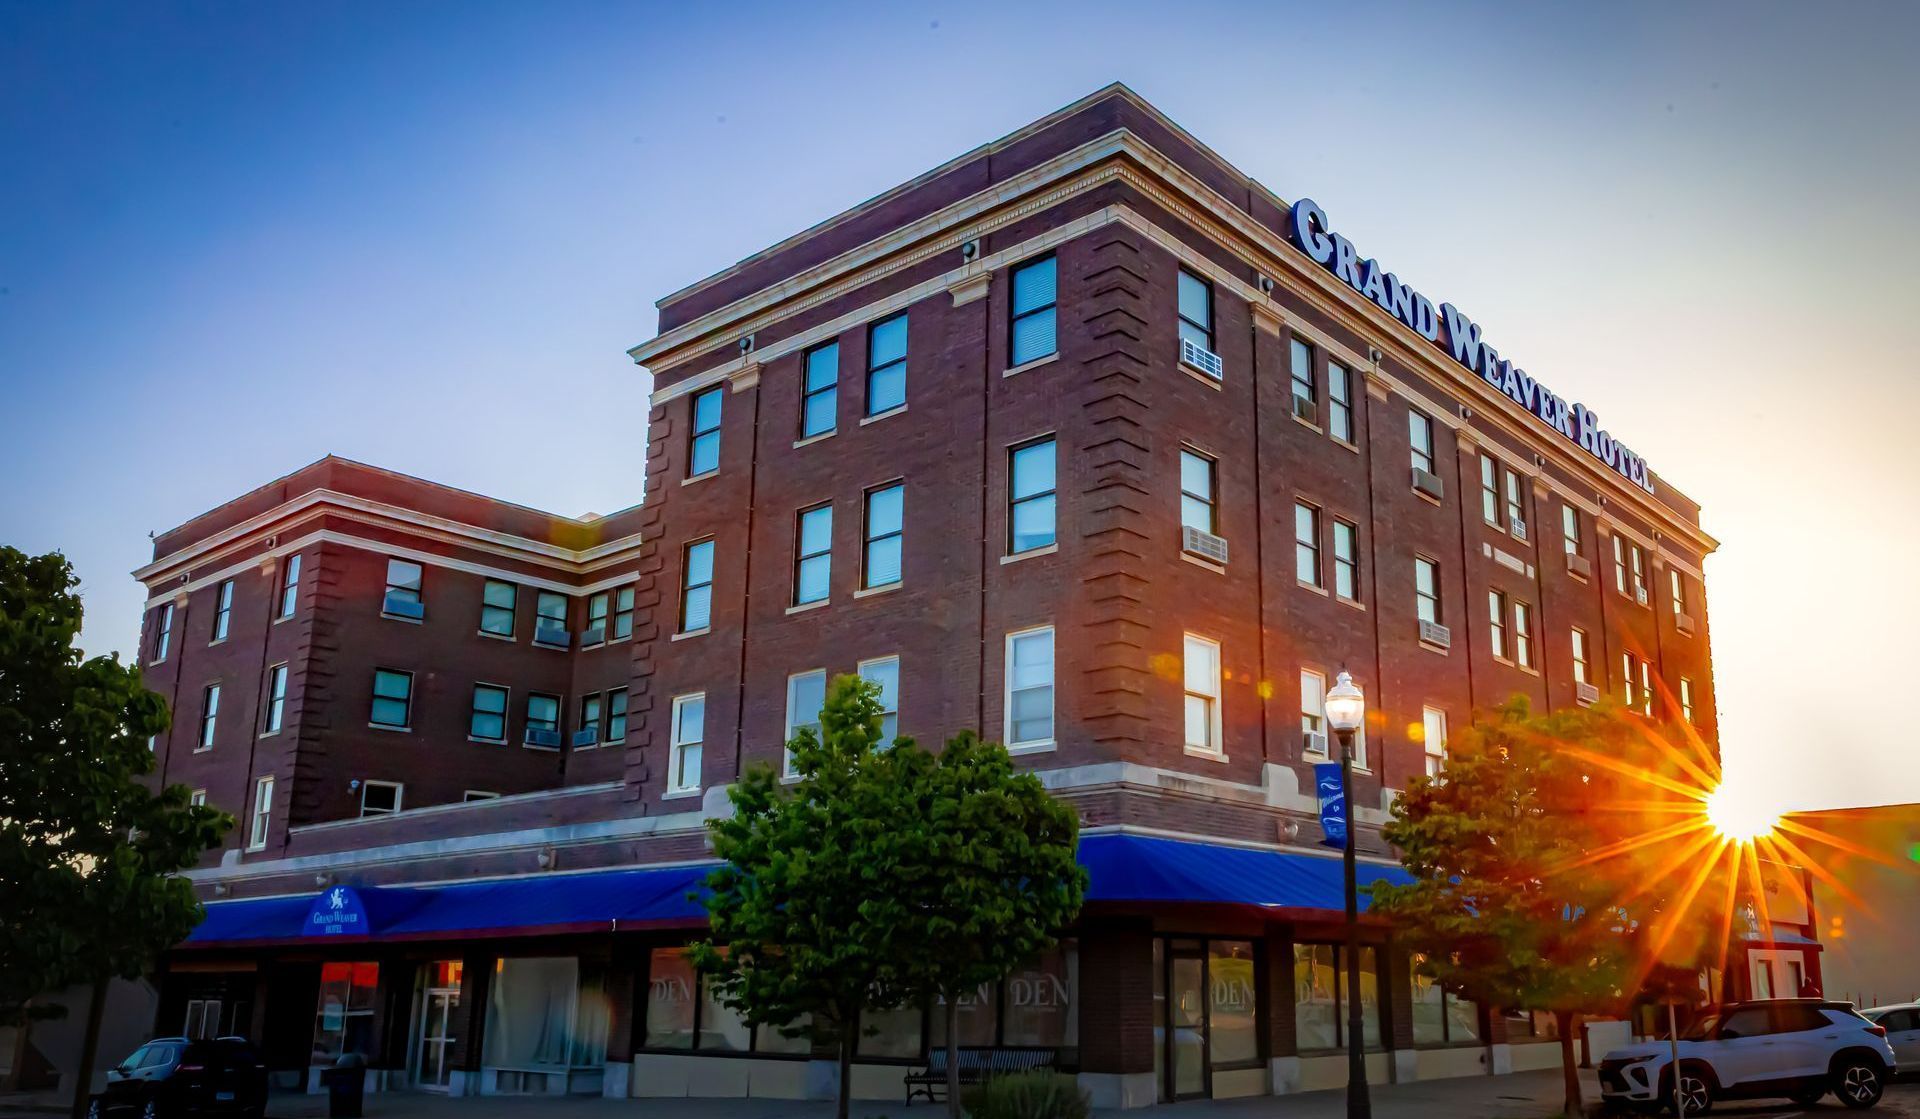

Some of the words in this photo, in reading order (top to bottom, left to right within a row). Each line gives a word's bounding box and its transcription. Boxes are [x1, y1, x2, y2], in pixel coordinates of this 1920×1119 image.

[1292, 198, 1439, 342] GRAND
[1440, 302, 1573, 439] WEAVER
[1573, 402, 1655, 495] HOTEL
[1010, 972, 1073, 1006] DEN
[1212, 975, 1256, 1005] DEN
